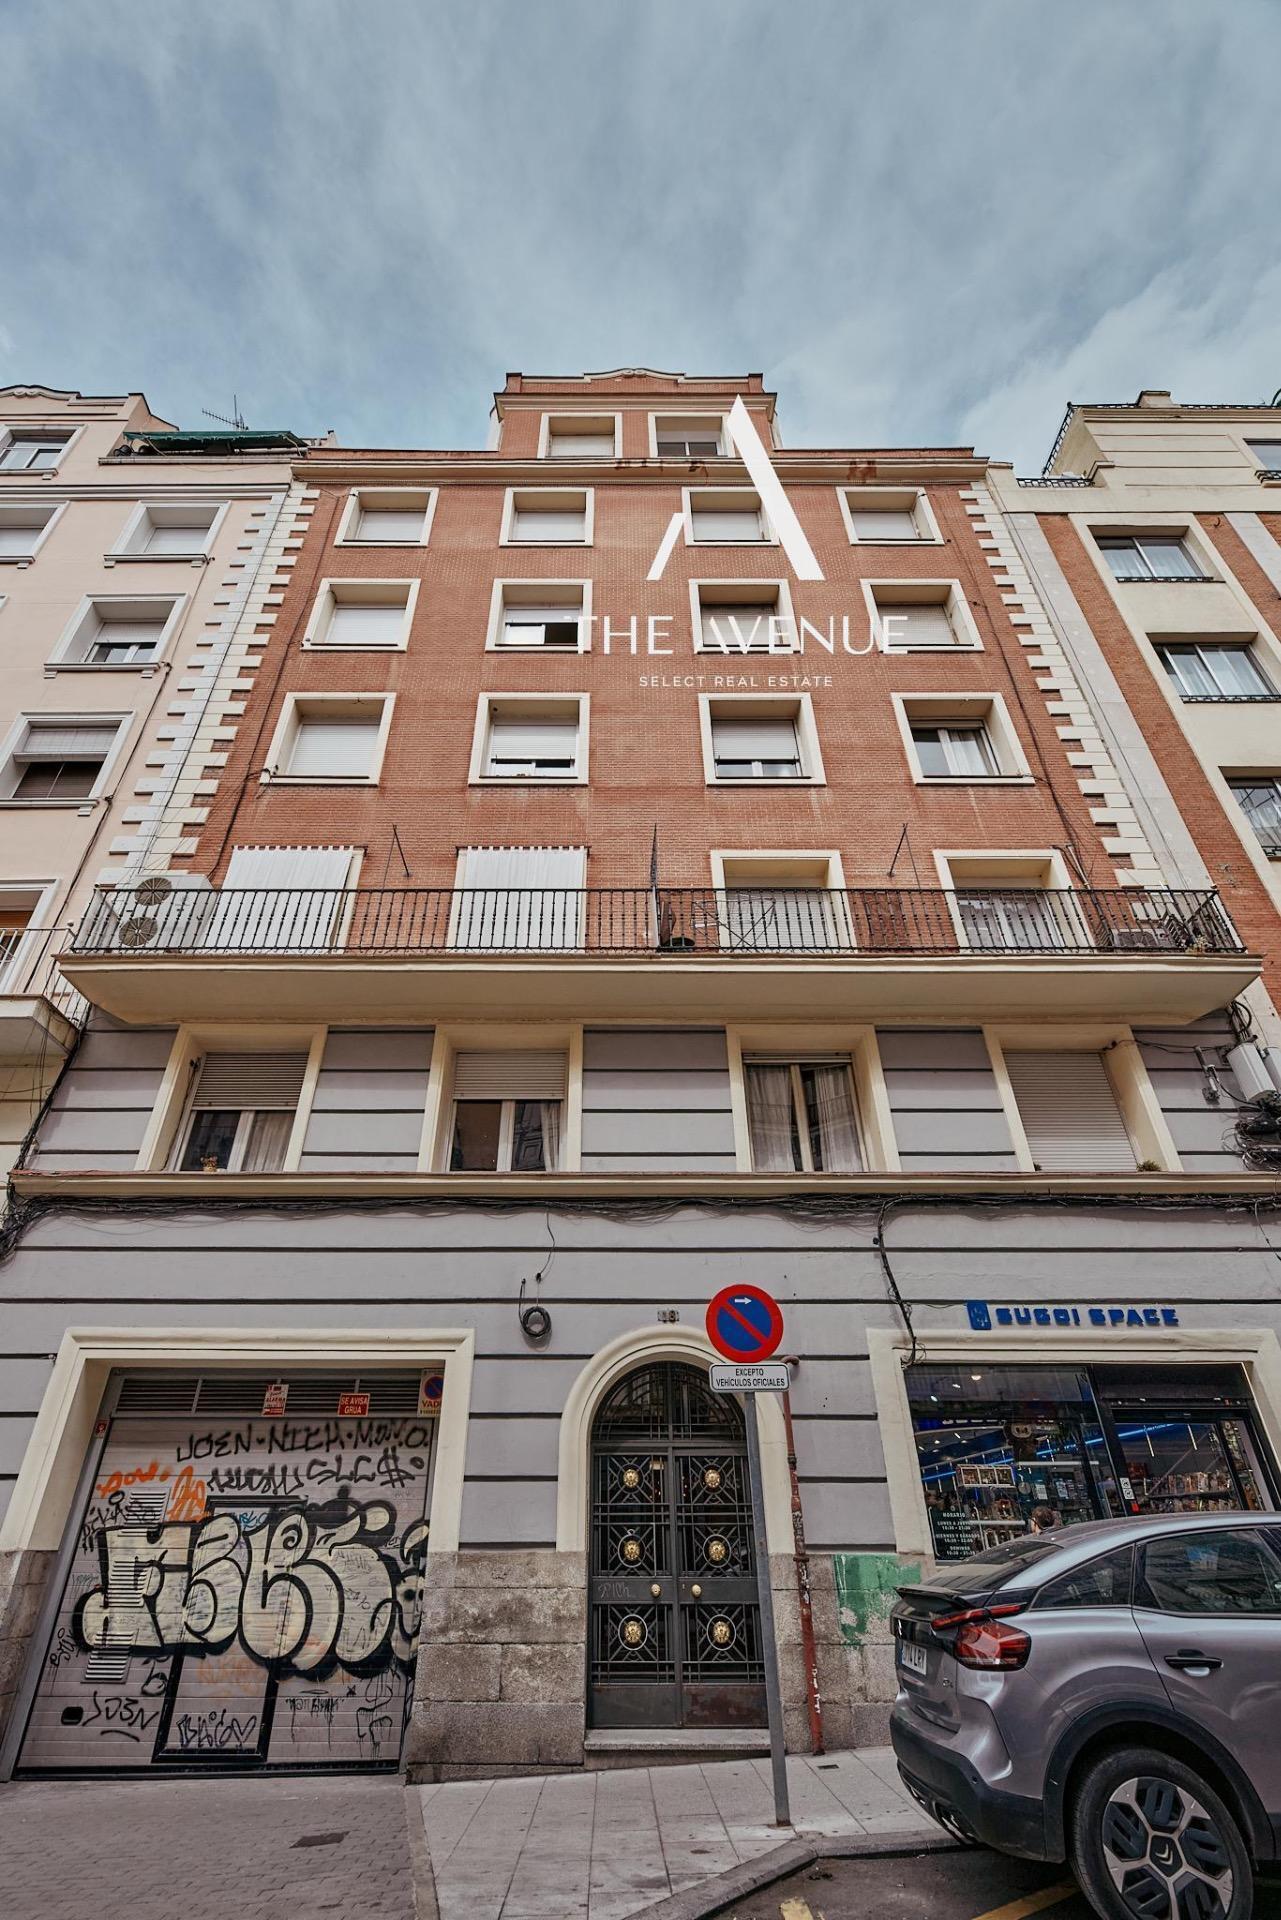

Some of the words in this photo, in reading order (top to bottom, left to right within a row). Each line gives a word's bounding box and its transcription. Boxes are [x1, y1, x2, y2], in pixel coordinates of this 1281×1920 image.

[1088, 1308, 1179, 1327] SPACE
[735, 1368, 764, 1376] EXCEPTO
[715, 1377, 752, 1387] VEHÍCULOS
[752, 1378, 785, 1387] OFICIALES
[341, 1396, 349, 1405] SE
[350, 1396, 368, 1405] AVISA
[421, 1399, 442, 1409] VAD
[344, 1406, 362, 1415] GRUA
